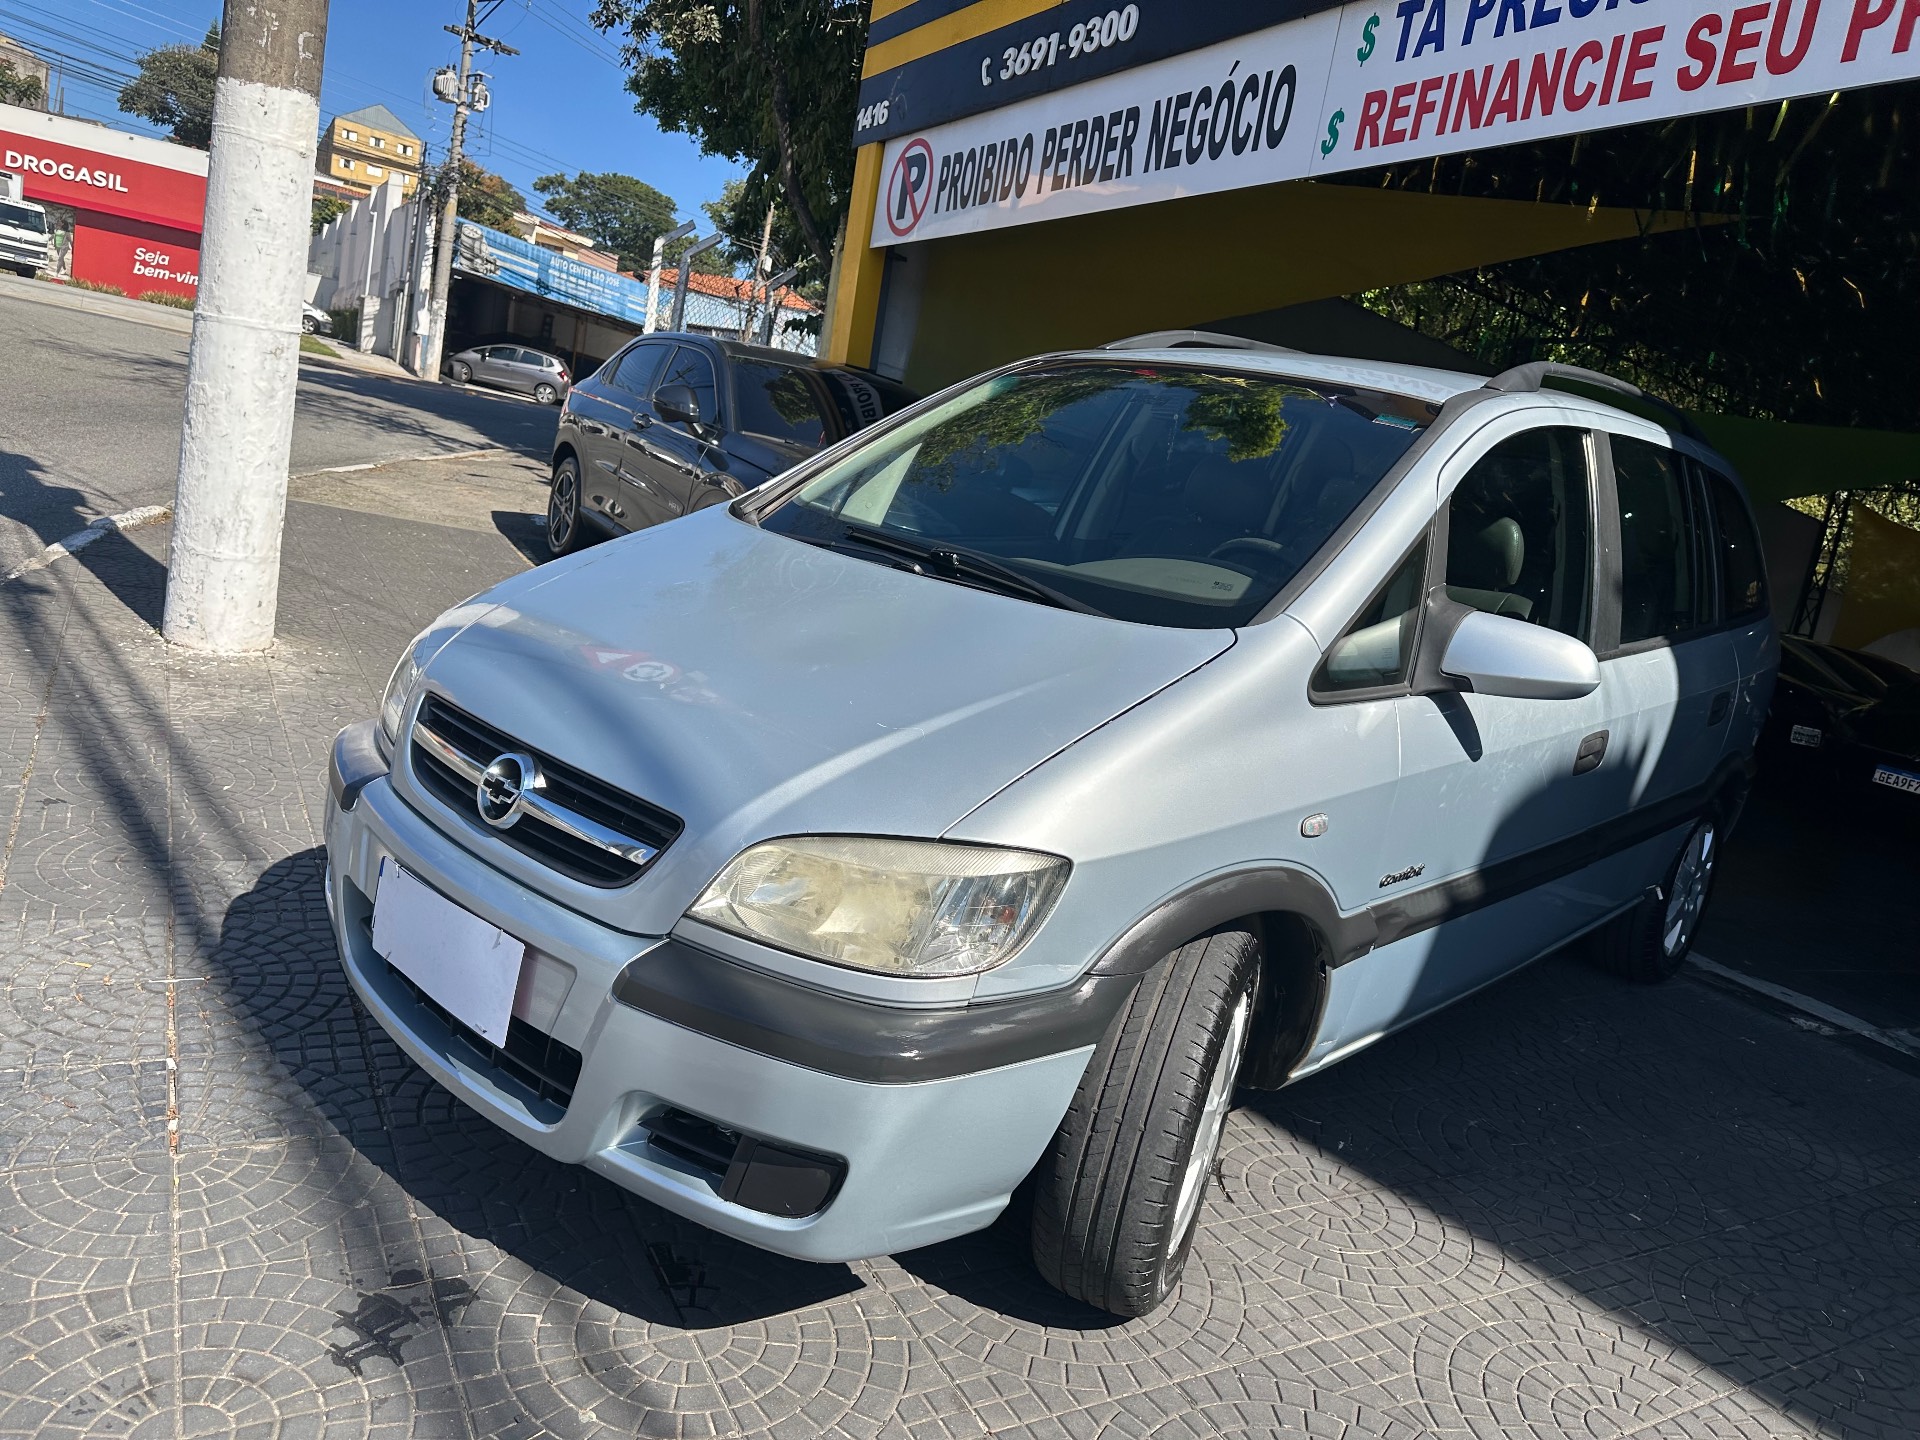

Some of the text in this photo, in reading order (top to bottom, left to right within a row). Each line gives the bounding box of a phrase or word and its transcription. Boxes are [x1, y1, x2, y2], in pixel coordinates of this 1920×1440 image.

[999, 3, 1140, 81] 3691-9300
[1395, 0, 1446, 63] TA
[1354, 25, 1667, 151] REFINANCIE
[1676, 0, 1822, 92] SEU
[856, 100, 890, 132] 1416
[934, 59, 1297, 214] PROIBIDO PERDER NEGÓCIO
[4, 150, 129, 193] DROGASIL
[133, 247, 170, 266] Seja
